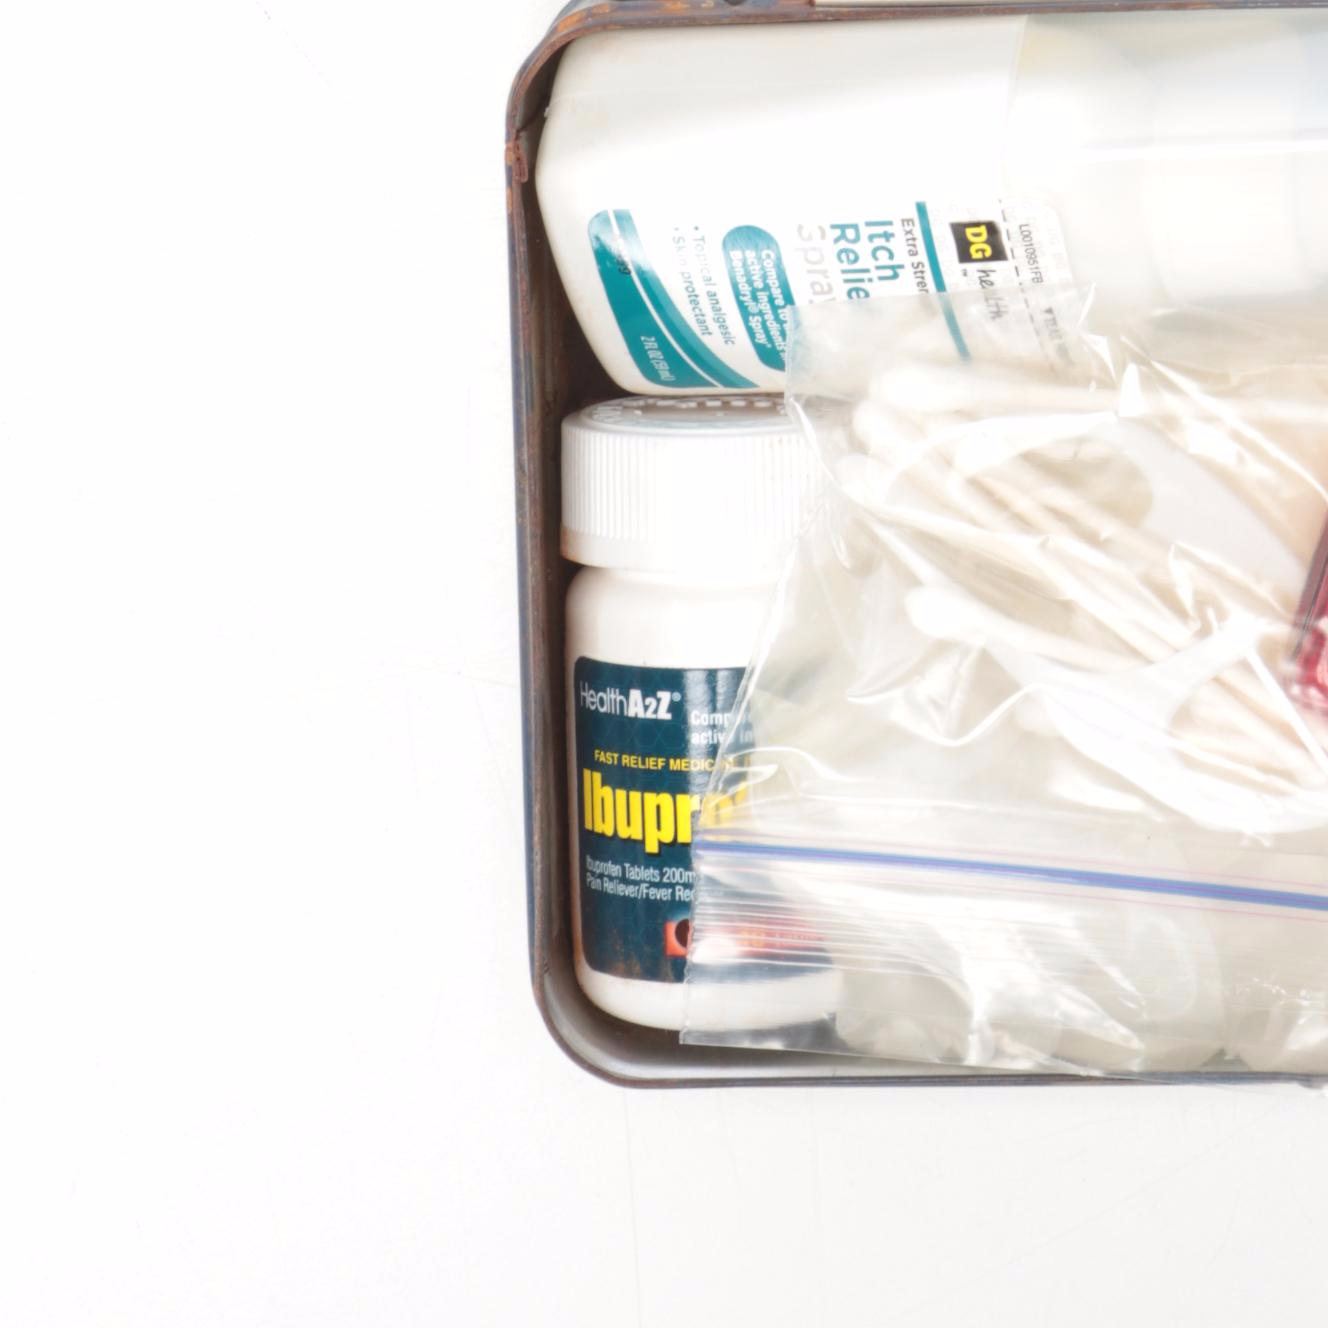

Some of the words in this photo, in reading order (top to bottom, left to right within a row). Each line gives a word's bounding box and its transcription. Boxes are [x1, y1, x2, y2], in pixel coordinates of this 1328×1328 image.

[830, 223, 870, 300] Relie
[865, 220, 905, 281] Itch
[901, 218, 919, 257] Extra
[965, 225, 992, 259] DG
[744, 250, 764, 289] active
[761, 249, 786, 306] Compare
[679, 270, 713, 337] protectant
[706, 287, 735, 346] analgesic
[594, 749, 618, 766] FAST
[621, 754, 666, 770] RELIEF
[582, 768, 701, 854] Ibupr
[585, 854, 622, 880] Ibuprofen
[624, 863, 660, 883] Tablets
[662, 867, 697, 885] 200m
[585, 877, 603, 892] Pain
[603, 880, 673, 902] Reliever/Fever
